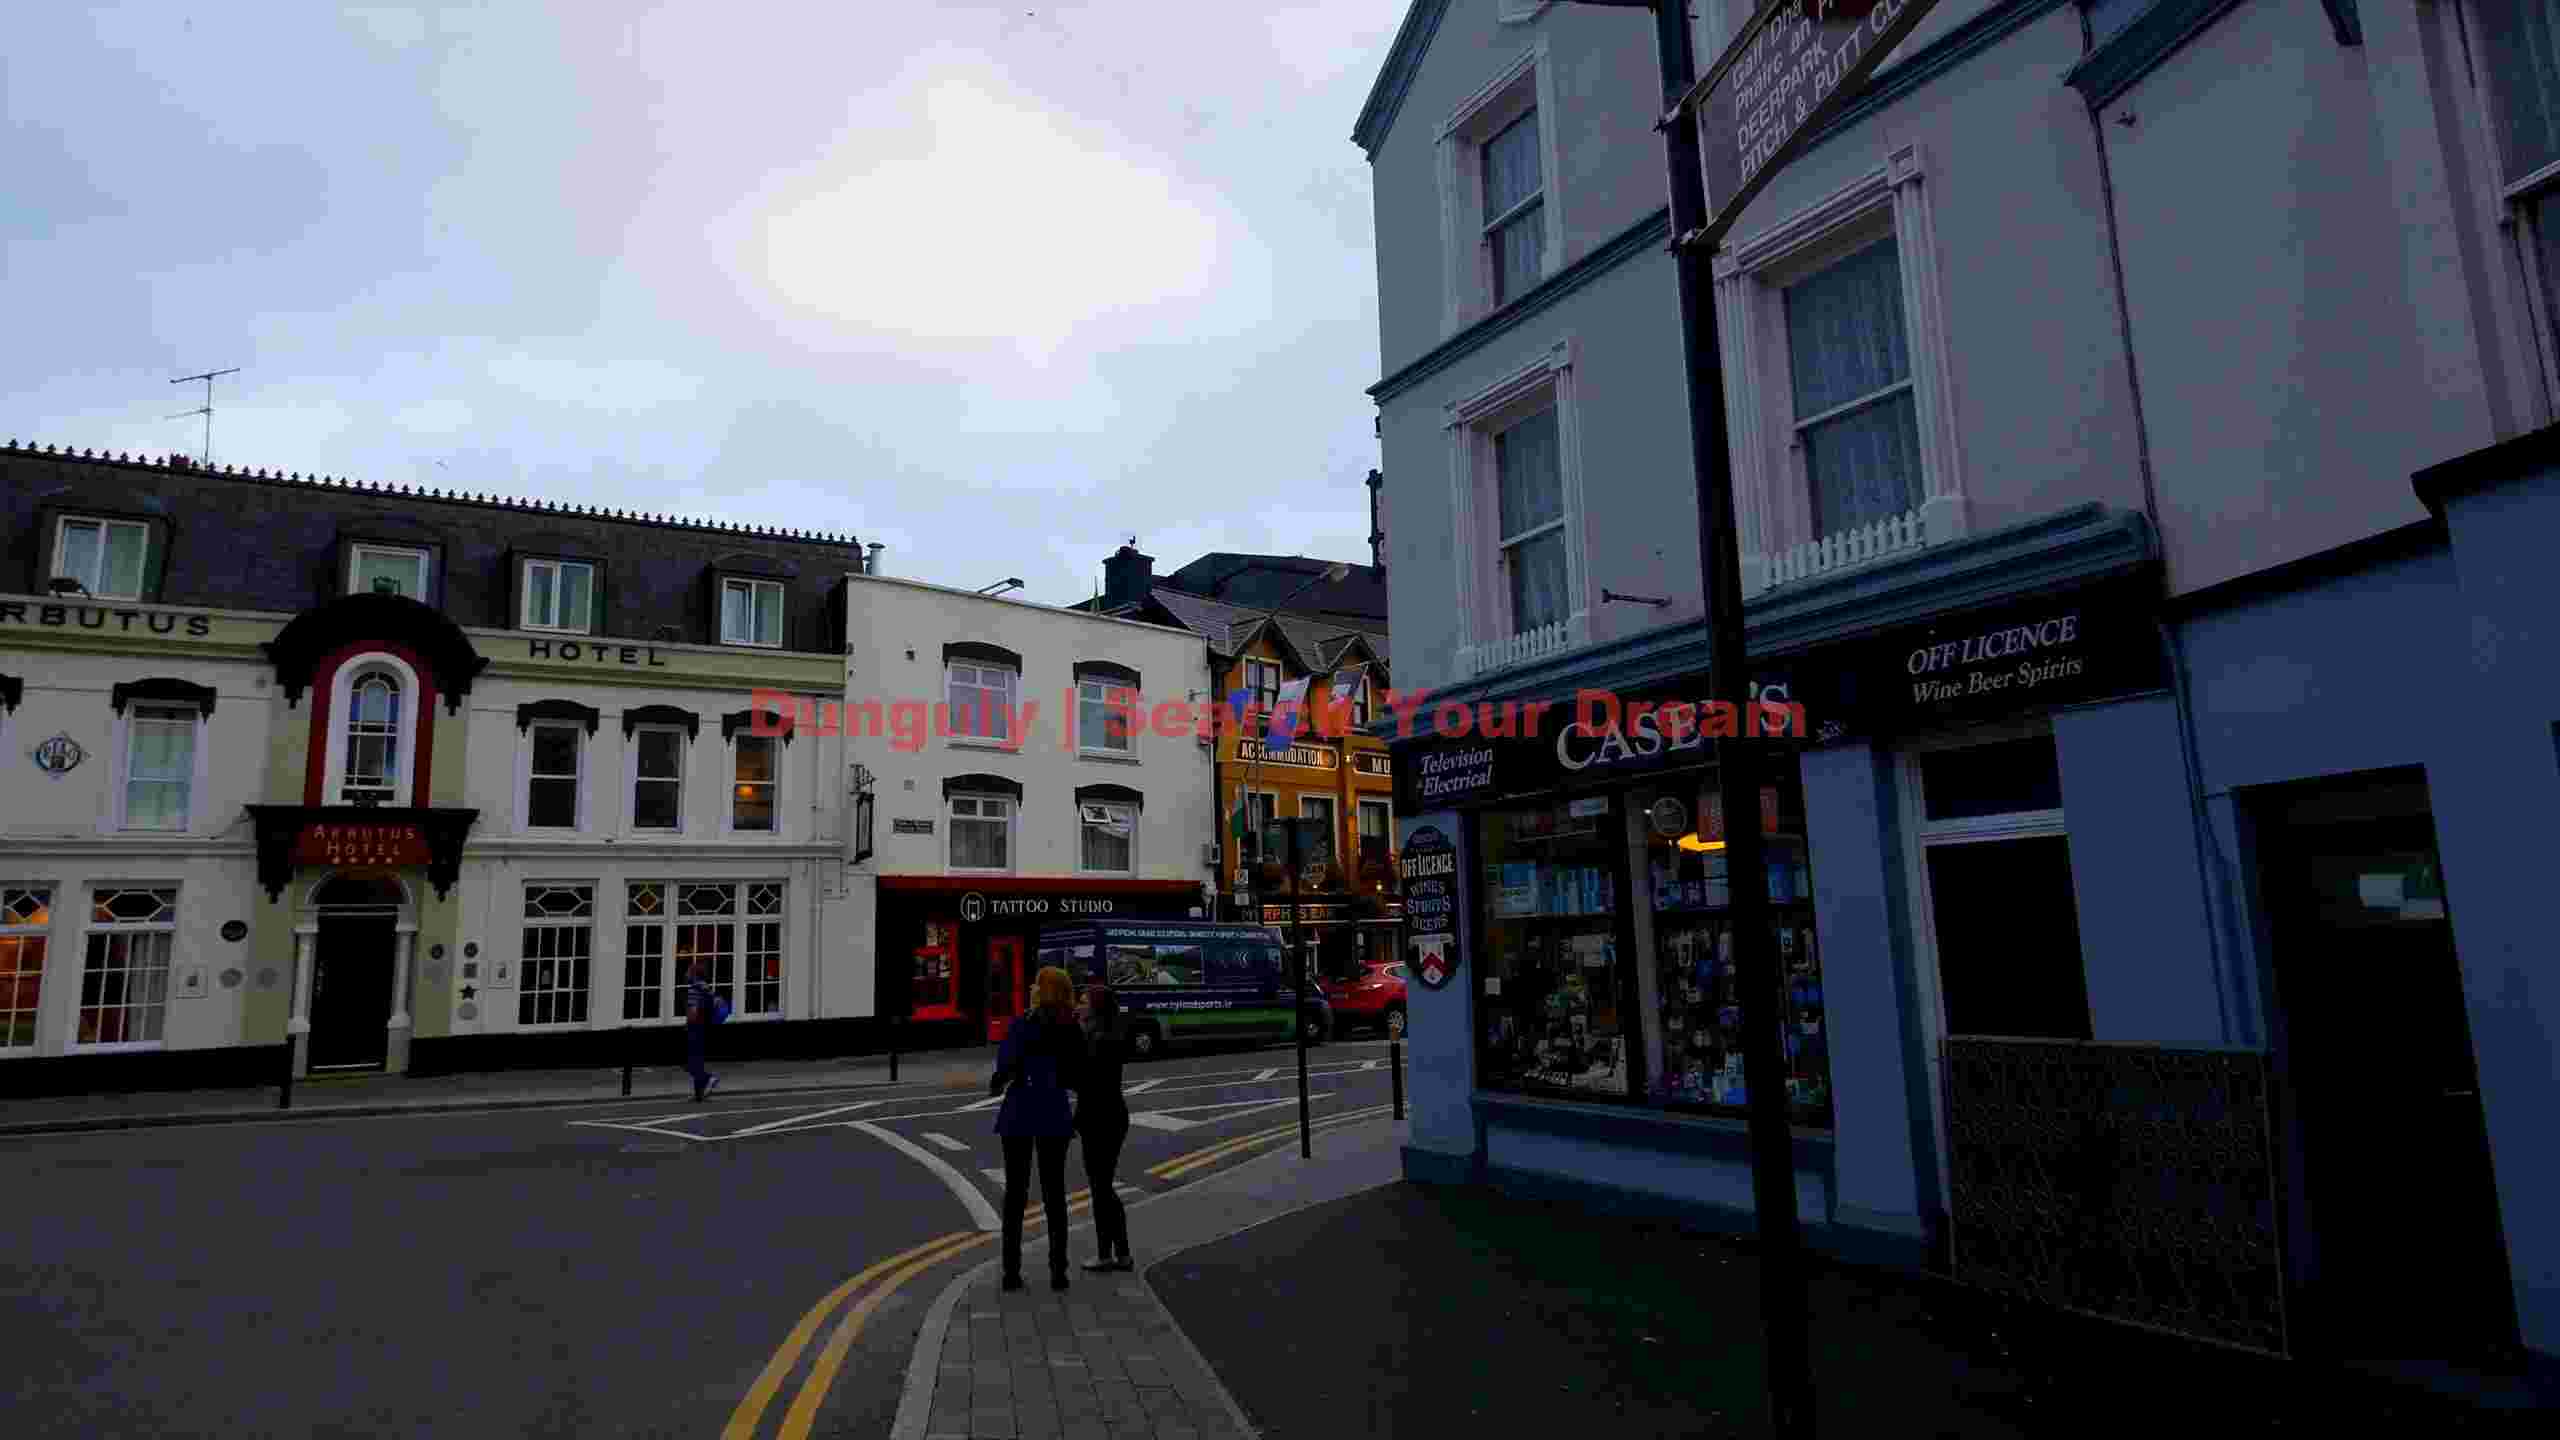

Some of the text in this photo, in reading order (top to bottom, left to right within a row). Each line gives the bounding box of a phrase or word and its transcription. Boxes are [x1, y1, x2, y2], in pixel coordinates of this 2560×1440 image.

[1737, 32, 1829, 152] DEERPARK
[1741, 119, 1788, 185] PITCH
[1795, 95, 1808, 123] &
[1815, 25, 1863, 102] PUTT
[530, 639, 665, 667] HOTEL
[1907, 615, 2078, 675] OFF LICENCE
[1911, 655, 2084, 704] Wine Beer Spirits
[1556, 680, 1792, 771] CASE'S
[1372, 756, 1391, 774] MU
[1420, 746, 1495, 775] Television
[1424, 764, 1494, 796] Electrical
[990, 897, 1113, 913] TATTOO STUDIO
